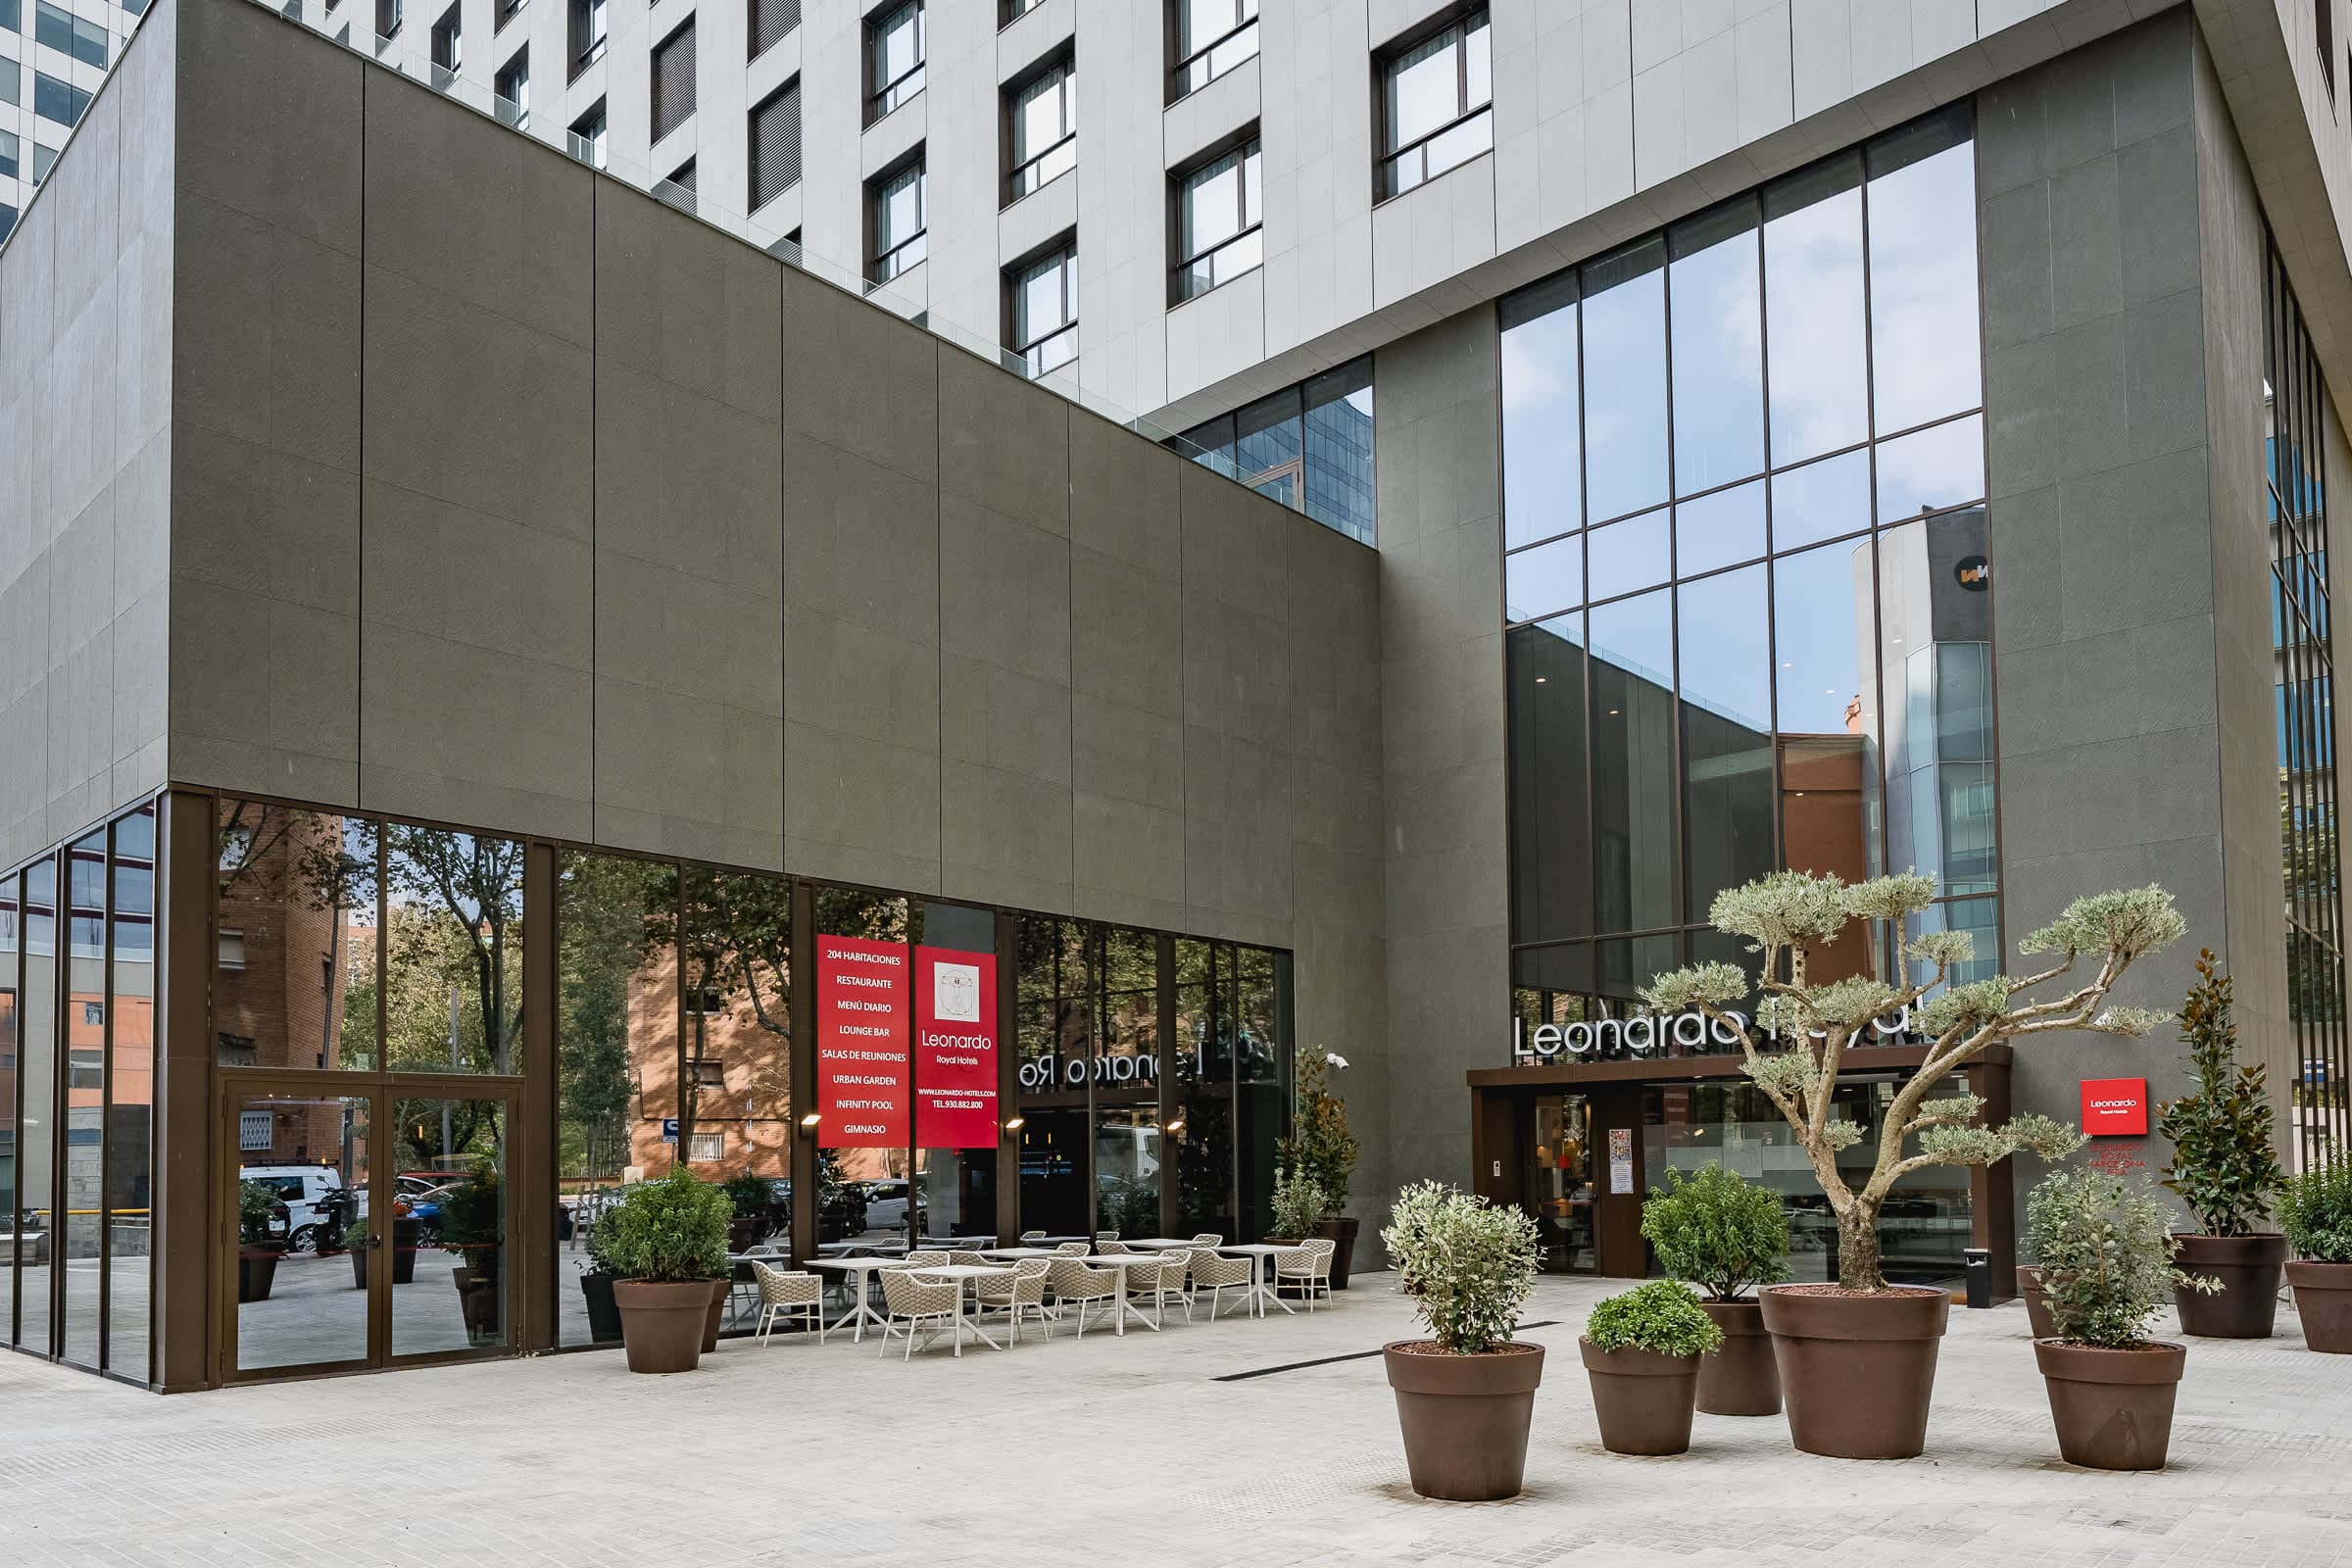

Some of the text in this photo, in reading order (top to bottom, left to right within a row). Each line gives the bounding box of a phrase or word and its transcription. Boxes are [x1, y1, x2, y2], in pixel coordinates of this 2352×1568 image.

[826, 950, 901, 965] 204 HABITACIONES
[836, 975, 893, 989] RESTAURANTE
[837, 1000, 892, 1013] MENÚ DIARIO
[839, 1025, 890, 1037] LOUNGE BAR
[1515, 1004, 1744, 1055] Leonardo
[922, 1029, 992, 1050] Leonardo
[821, 1049, 906, 1062] SALAS DE REUNIONES
[936, 1054, 979, 1065] Royal Hotels
[832, 1075, 897, 1086] URBAN GARDEN
[917, 1088, 997, 1098] WWW.LEONARDO-HOTELS.COM
[836, 1100, 894, 1109] INFINITY POOL
[2089, 1099, 2137, 1108] Leonardo
[844, 1124, 886, 1134] GIMNASIO
